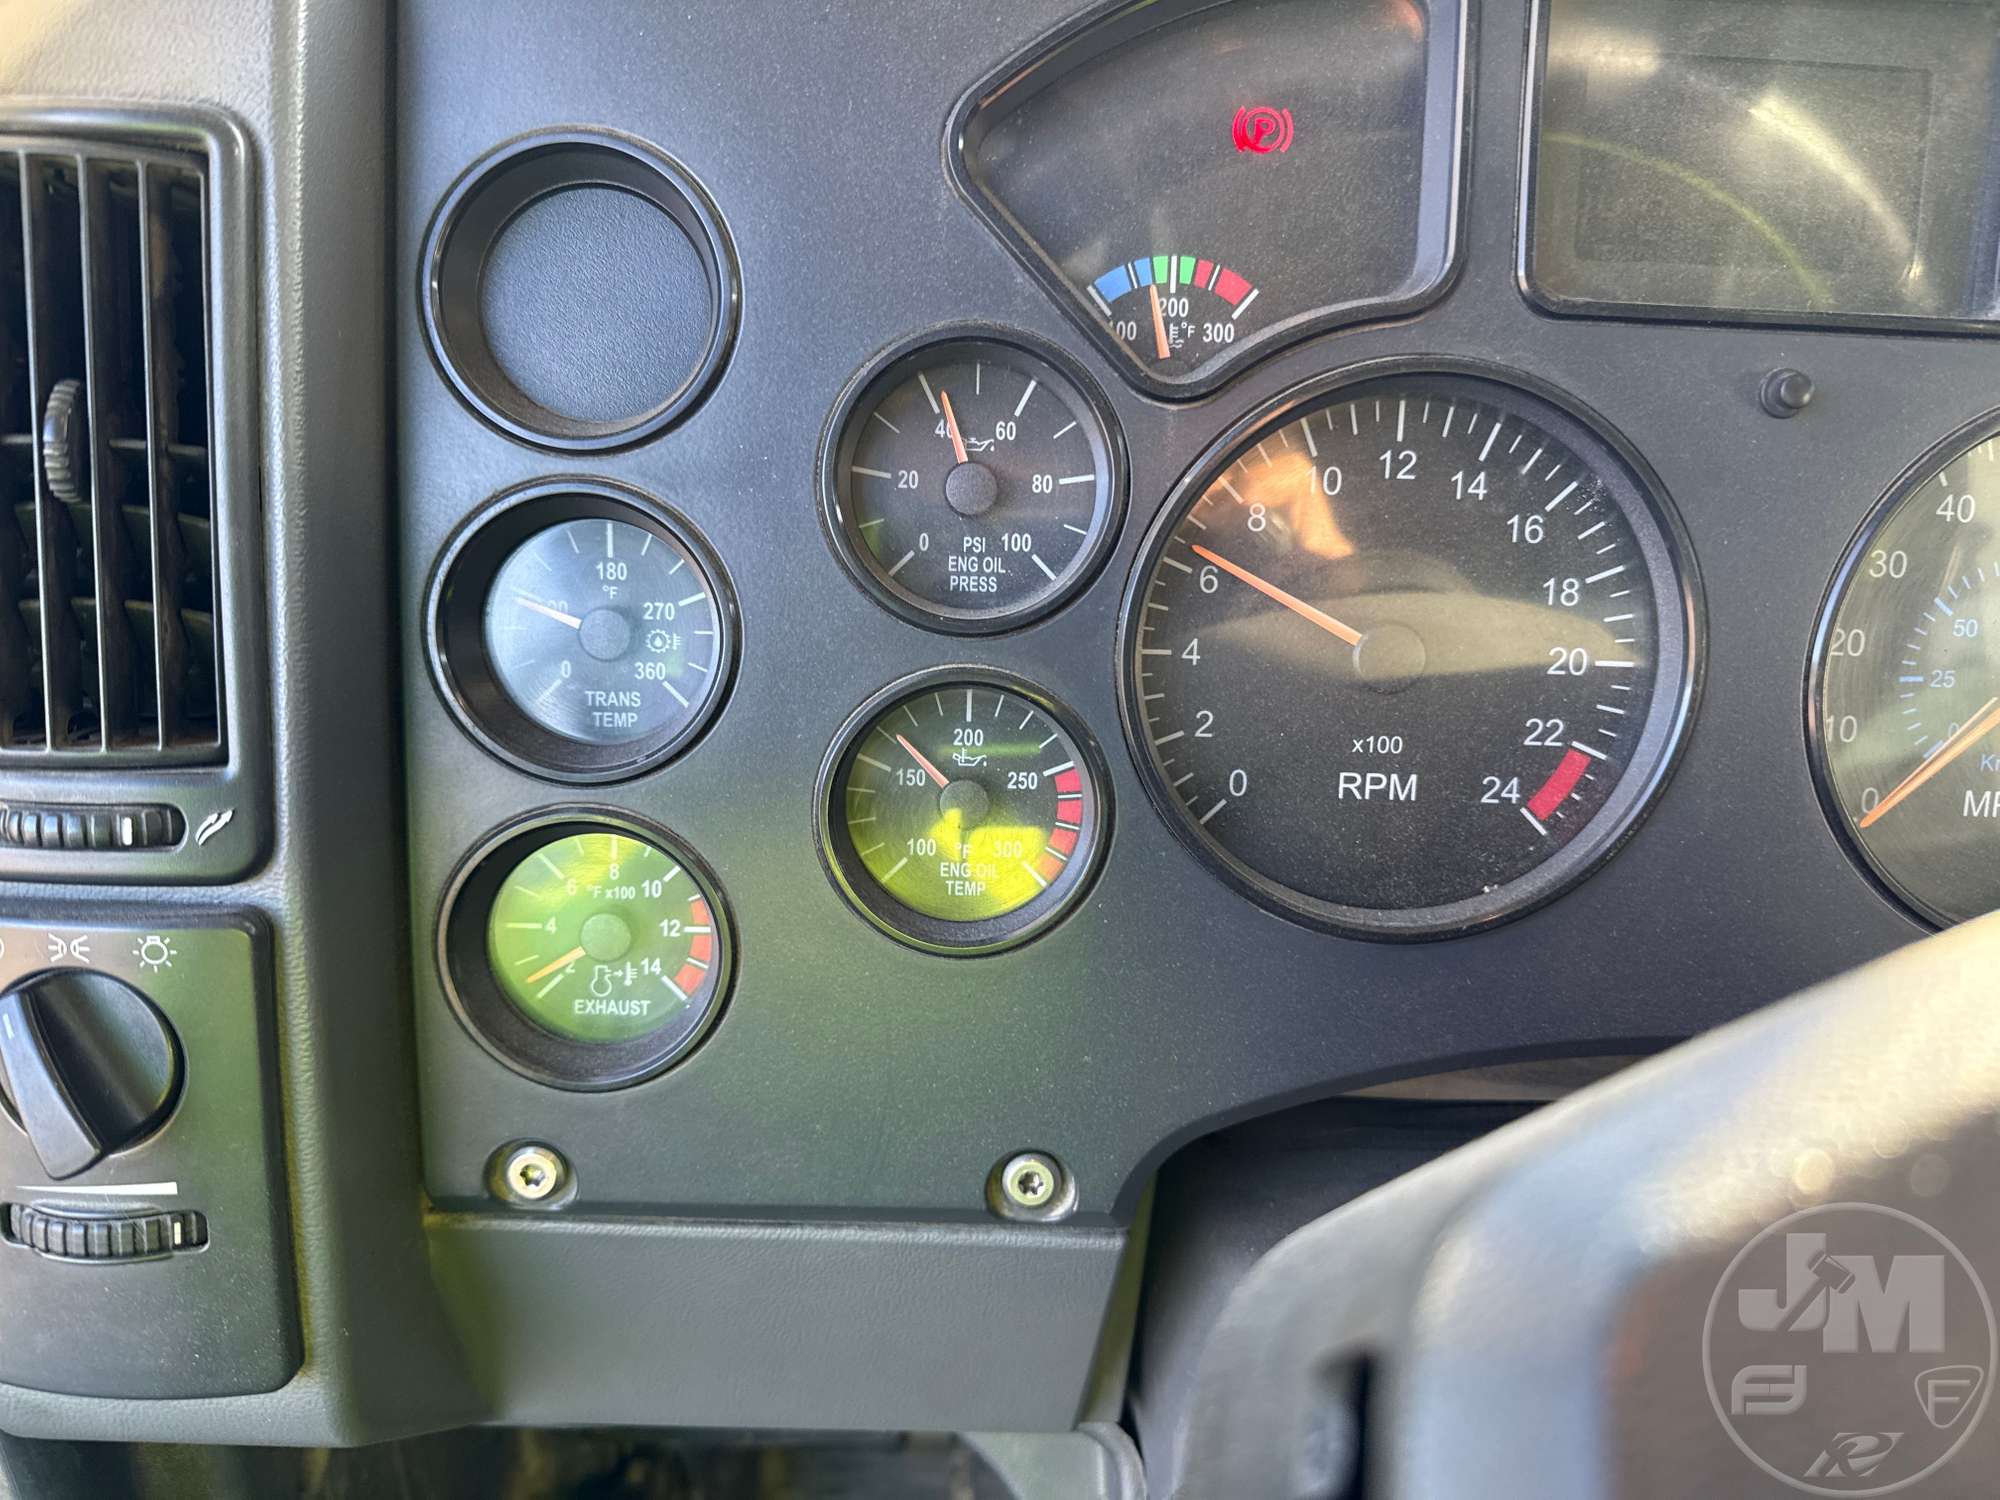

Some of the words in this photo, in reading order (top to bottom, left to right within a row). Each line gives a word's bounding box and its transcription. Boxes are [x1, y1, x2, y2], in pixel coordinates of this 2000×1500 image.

[1157, 297, 1189, 318] 200
[1110, 320, 1138, 341] 00
[1203, 322, 1235, 343] 300
[995, 421, 1017, 441] 60
[1379, 449, 1418, 480] 12
[898, 470, 919, 489] 20
[1031, 474, 1053, 494] 80
[1307, 465, 1343, 496] 10
[1450, 470, 1488, 501] 14
[1246, 503, 1267, 532] 8
[1935, 494, 1976, 524] 40
[1505, 513, 1545, 544] 16
[919, 532, 930, 551] 0
[963, 536, 986, 552] PSI
[1001, 533, 1032, 552] 100
[596, 562, 628, 581] 180
[948, 555, 978, 573] ENG
[982, 556, 1006, 574] OIL
[1868, 550, 1908, 579] 30
[950, 575, 998, 593] PRESS
[1198, 565, 1220, 595] 6
[1542, 577, 1581, 606] 18
[643, 602, 675, 621] 270
[1952, 619, 1979, 638] 50
[1180, 637, 1202, 666] 4
[1829, 628, 1866, 657] 20
[560, 660, 572, 679] 0
[1546, 646, 1589, 676] 20
[634, 662, 666, 681] 360
[1929, 670, 1955, 689] 25
[584, 690, 641, 708] TRANS
[592, 711, 639, 728] TEMP
[1194, 710, 1215, 739] 2
[1826, 715, 1858, 743] 10
[953, 728, 984, 747] 200
[1523, 718, 1565, 748] 22
[1351, 735, 1404, 755] x100
[1980, 753, 2000, 772] K
[895, 768, 926, 787] 150
[1007, 772, 1038, 790] 250
[1228, 769, 1248, 797] 0
[1336, 771, 1419, 802] RPM
[1480, 776, 1521, 805] 24
[1860, 786, 1880, 815] 0
[906, 838, 937, 857] 100
[993, 841, 1022, 859] 300
[608, 864, 620, 880] 8
[939, 862, 971, 878] ENG
[975, 863, 998, 879] OIL
[566, 878, 577, 896] 6
[605, 886, 636, 900] x100
[641, 880, 663, 898] 10
[945, 880, 987, 897] TEMP
[545, 916, 557, 935] 4
[659, 919, 681, 937] 12
[641, 958, 662, 976] 14
[574, 999, 652, 1016] EXHAUST
